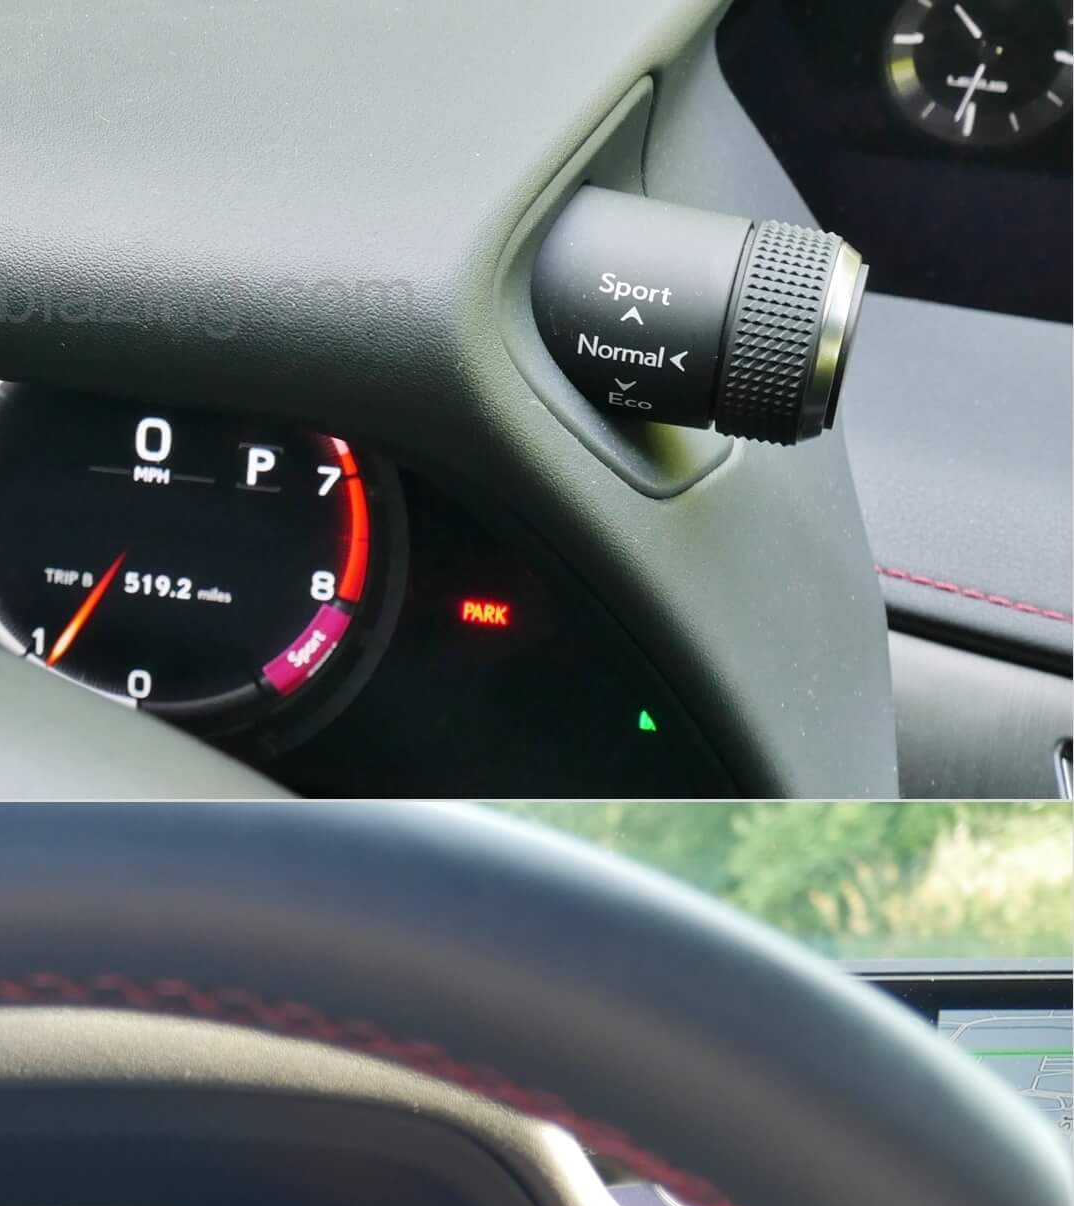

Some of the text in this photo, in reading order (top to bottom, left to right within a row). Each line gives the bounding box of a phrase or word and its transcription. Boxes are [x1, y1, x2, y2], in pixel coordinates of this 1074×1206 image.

[598, 272, 672, 306] Sport
[577, 333, 665, 368] Normal
[608, 391, 653, 410] Eco
[134, 417, 173, 463] 0
[133, 466, 171, 485] MPH
[245, 446, 276, 486] P
[316, 465, 341, 497] 7
[44, 567, 232, 604] TRIP B 519.2 miles
[310, 570, 336, 601] 8
[462, 601, 509, 626] PARK
[31, 627, 45, 656] 1
[287, 629, 326, 668] Sport
[127, 670, 152, 699] 0
